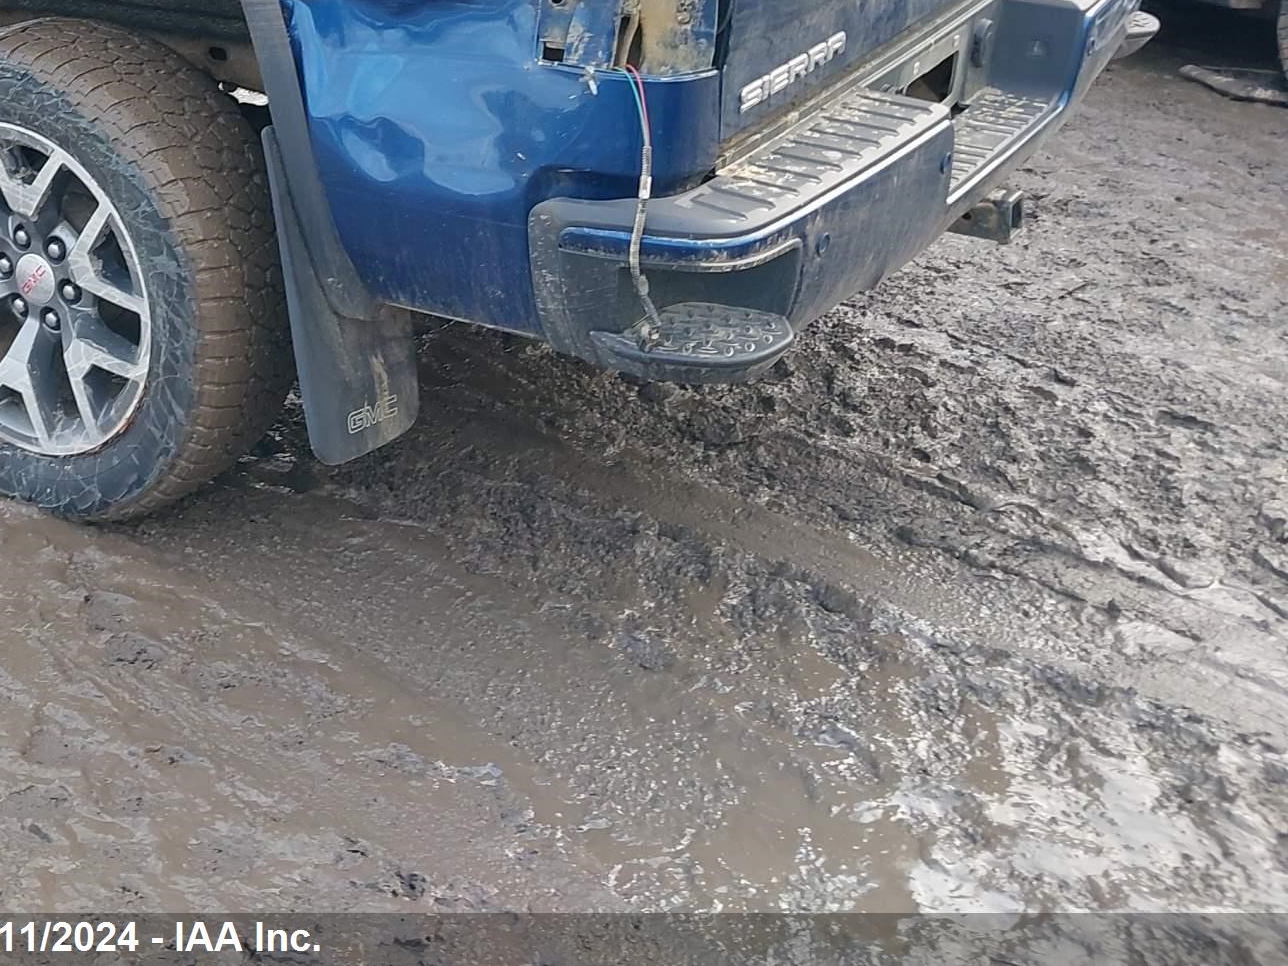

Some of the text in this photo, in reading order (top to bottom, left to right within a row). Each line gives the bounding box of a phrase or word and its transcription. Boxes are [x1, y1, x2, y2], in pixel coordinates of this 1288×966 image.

[739, 30, 847, 114] SIERRA
[22, 265, 47, 295] GMC
[347, 394, 399, 435] GMC
